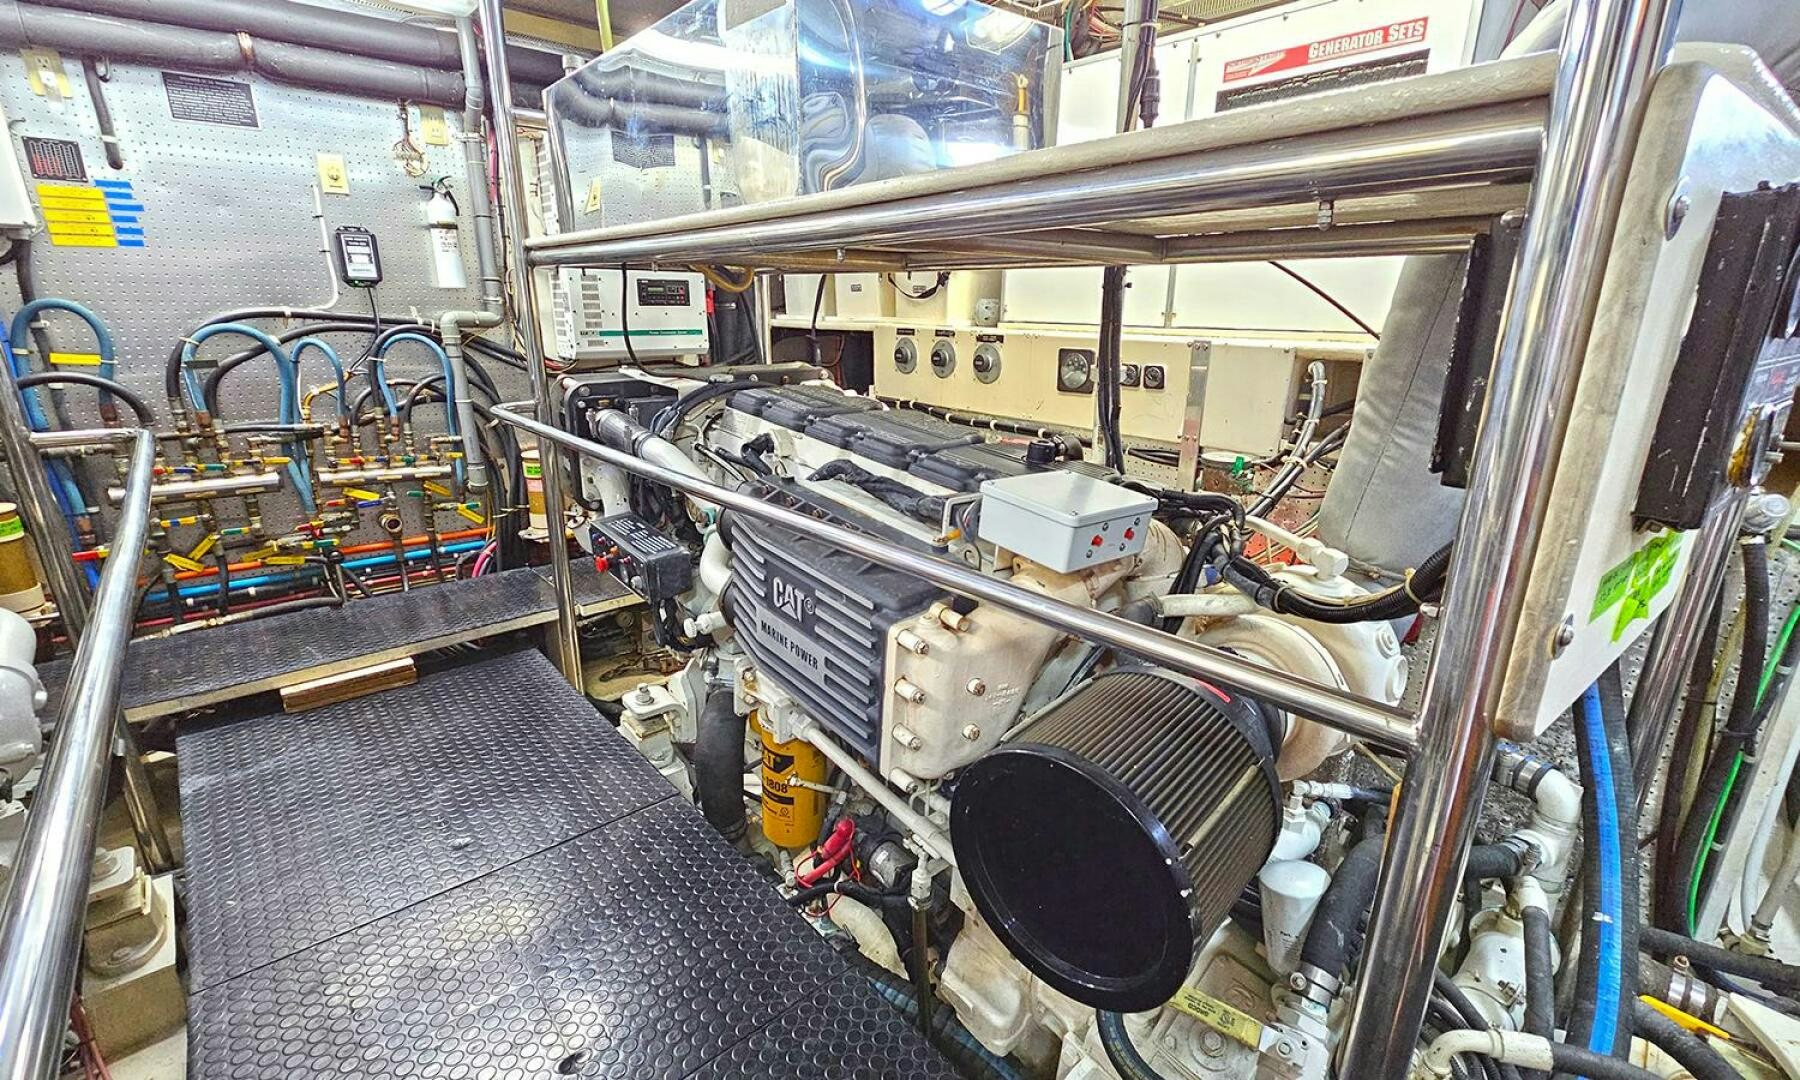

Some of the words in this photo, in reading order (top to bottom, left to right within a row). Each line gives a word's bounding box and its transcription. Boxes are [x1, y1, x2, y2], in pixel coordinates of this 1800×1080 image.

[1308, 29, 1384, 59] GENERATOR
[1388, 19, 1425, 43] SETS
[760, 620, 788, 650] MARINE
[790, 640, 818, 670] POWER
